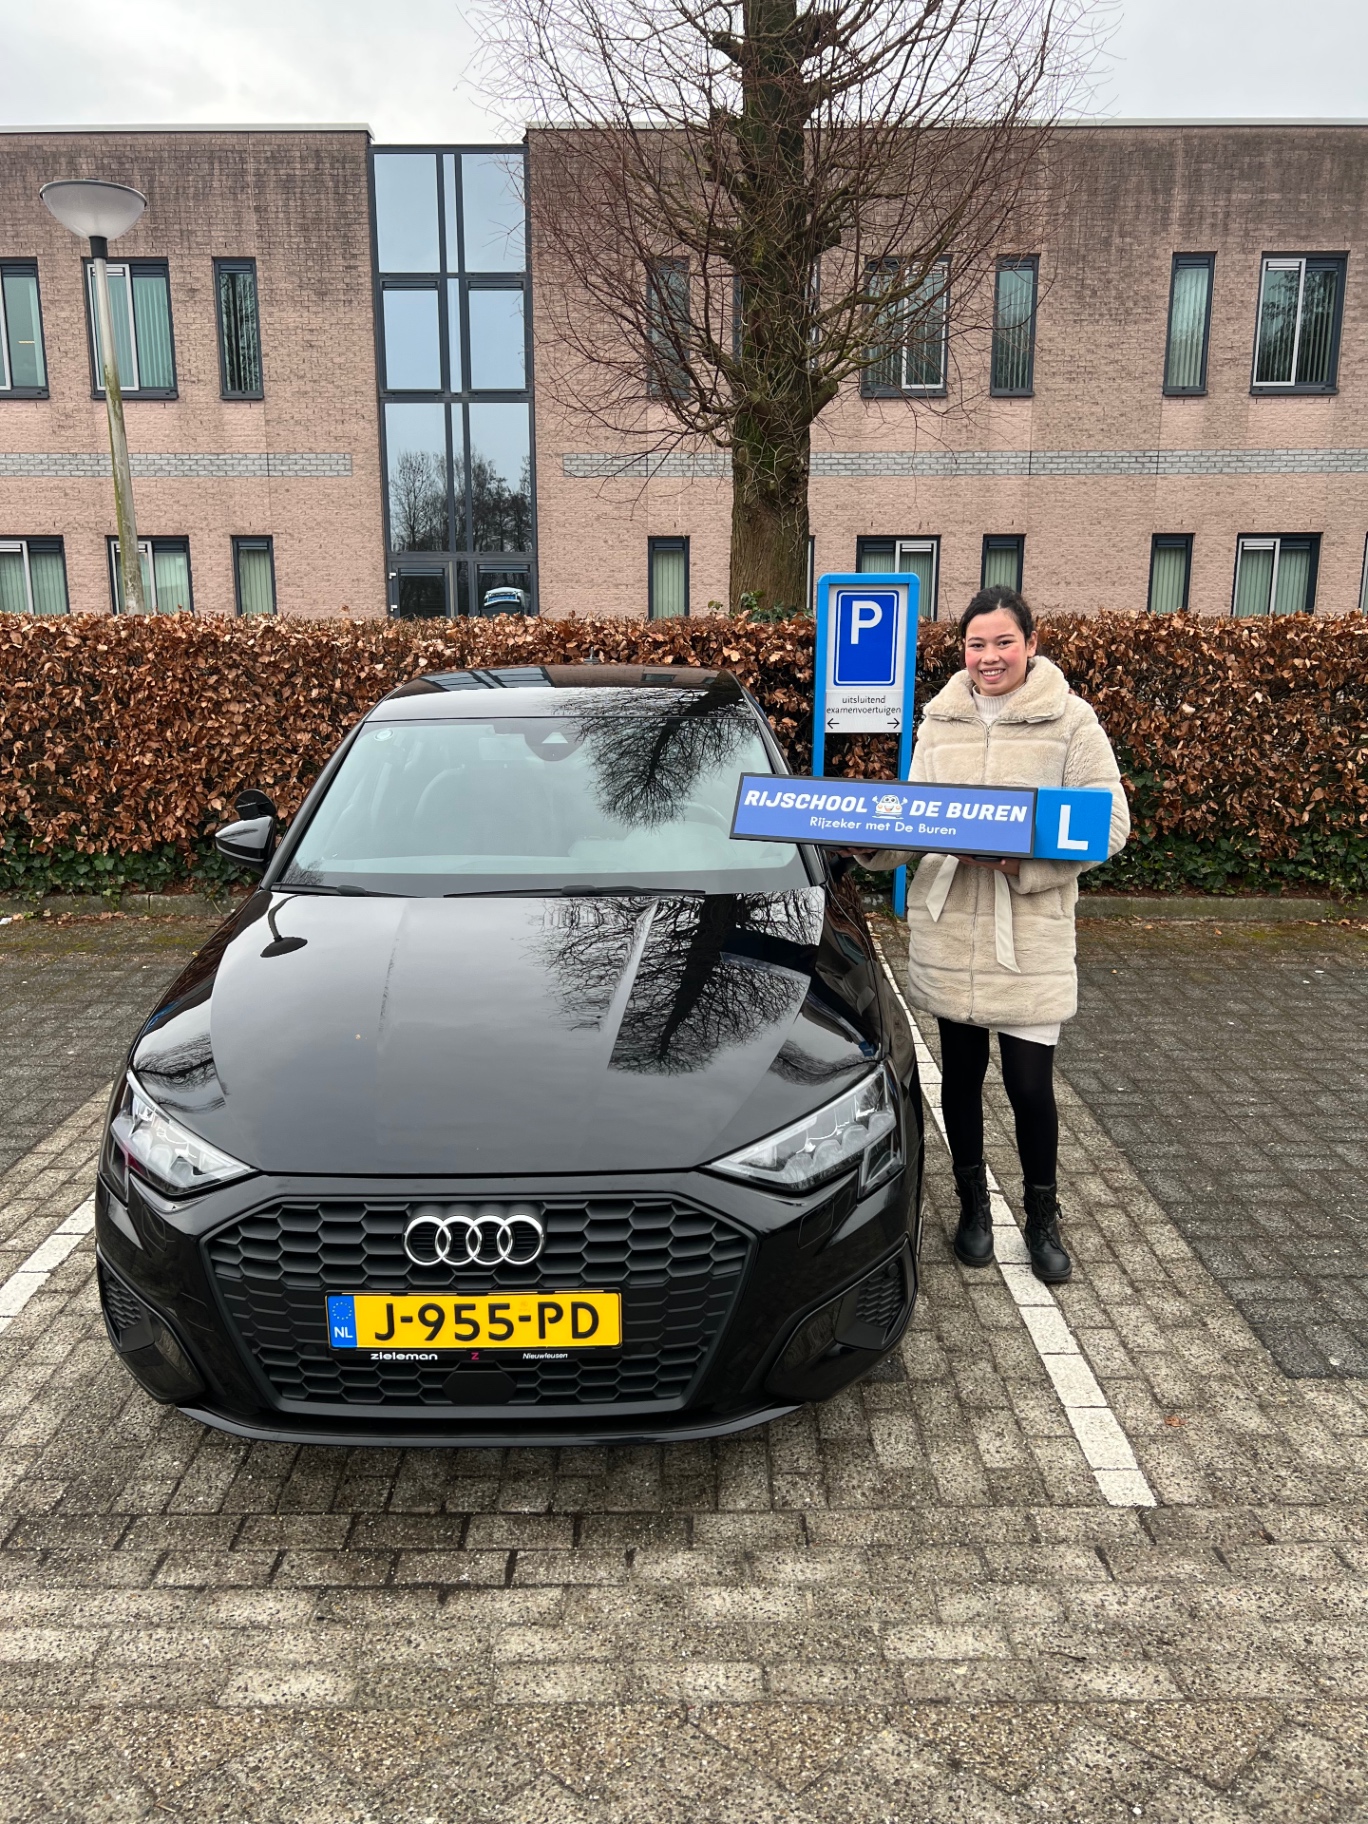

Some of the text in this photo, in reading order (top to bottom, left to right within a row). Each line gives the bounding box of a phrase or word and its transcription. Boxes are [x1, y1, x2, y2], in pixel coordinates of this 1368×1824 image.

[850, 600, 883, 645] P
[842, 695, 887, 704] uitsluitend
[826, 706, 902, 716] examenvoertuigen
[744, 790, 1028, 823] RIJSCHOOL DE BUREN
[809, 816, 957, 836] Rijzeker met De Buren
[1056, 804, 1089, 851] L
[374, 1301, 600, 1342] J-955-PD
[333, 1326, 354, 1338] NL
[370, 1351, 438, 1361] zieleman
